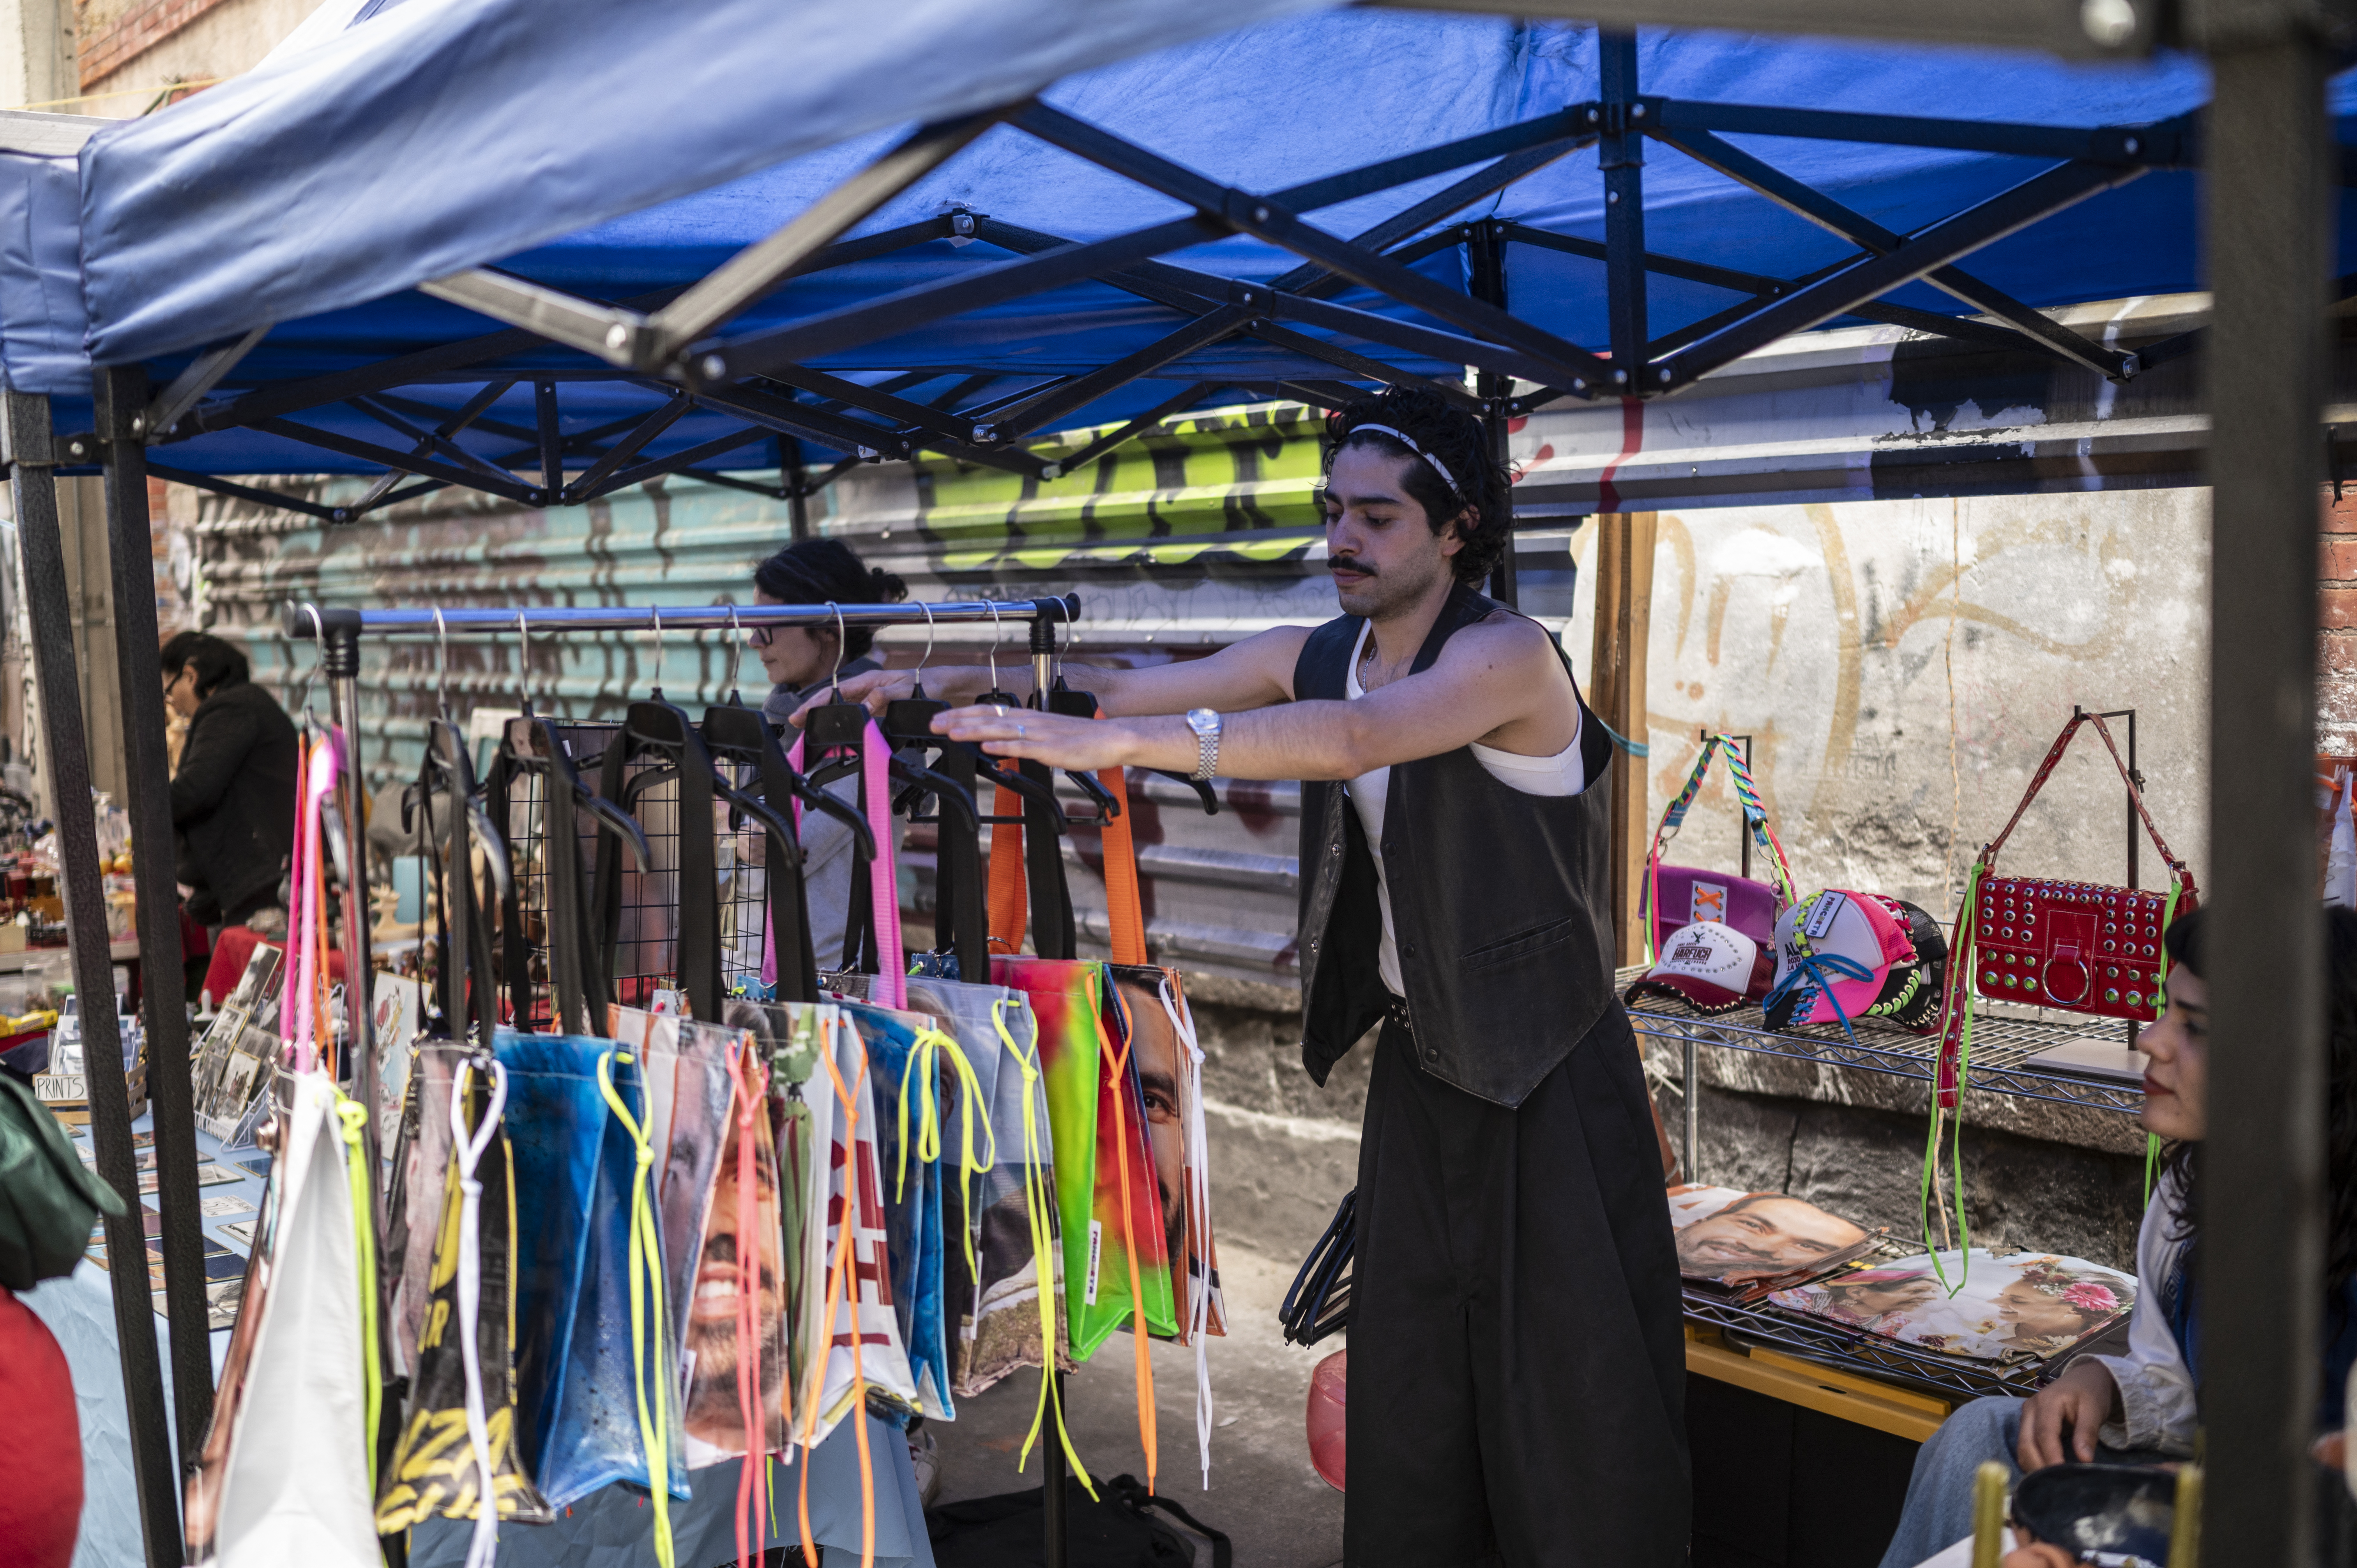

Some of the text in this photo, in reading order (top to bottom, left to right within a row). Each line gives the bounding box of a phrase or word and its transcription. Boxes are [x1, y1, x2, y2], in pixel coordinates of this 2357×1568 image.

[1810, 897, 1836, 935] PANCARTA
[1672, 947, 1712, 961] HARFUCH
[1787, 956, 1801, 965] ROJO
[37, 1077, 84, 1098] PRINTS
